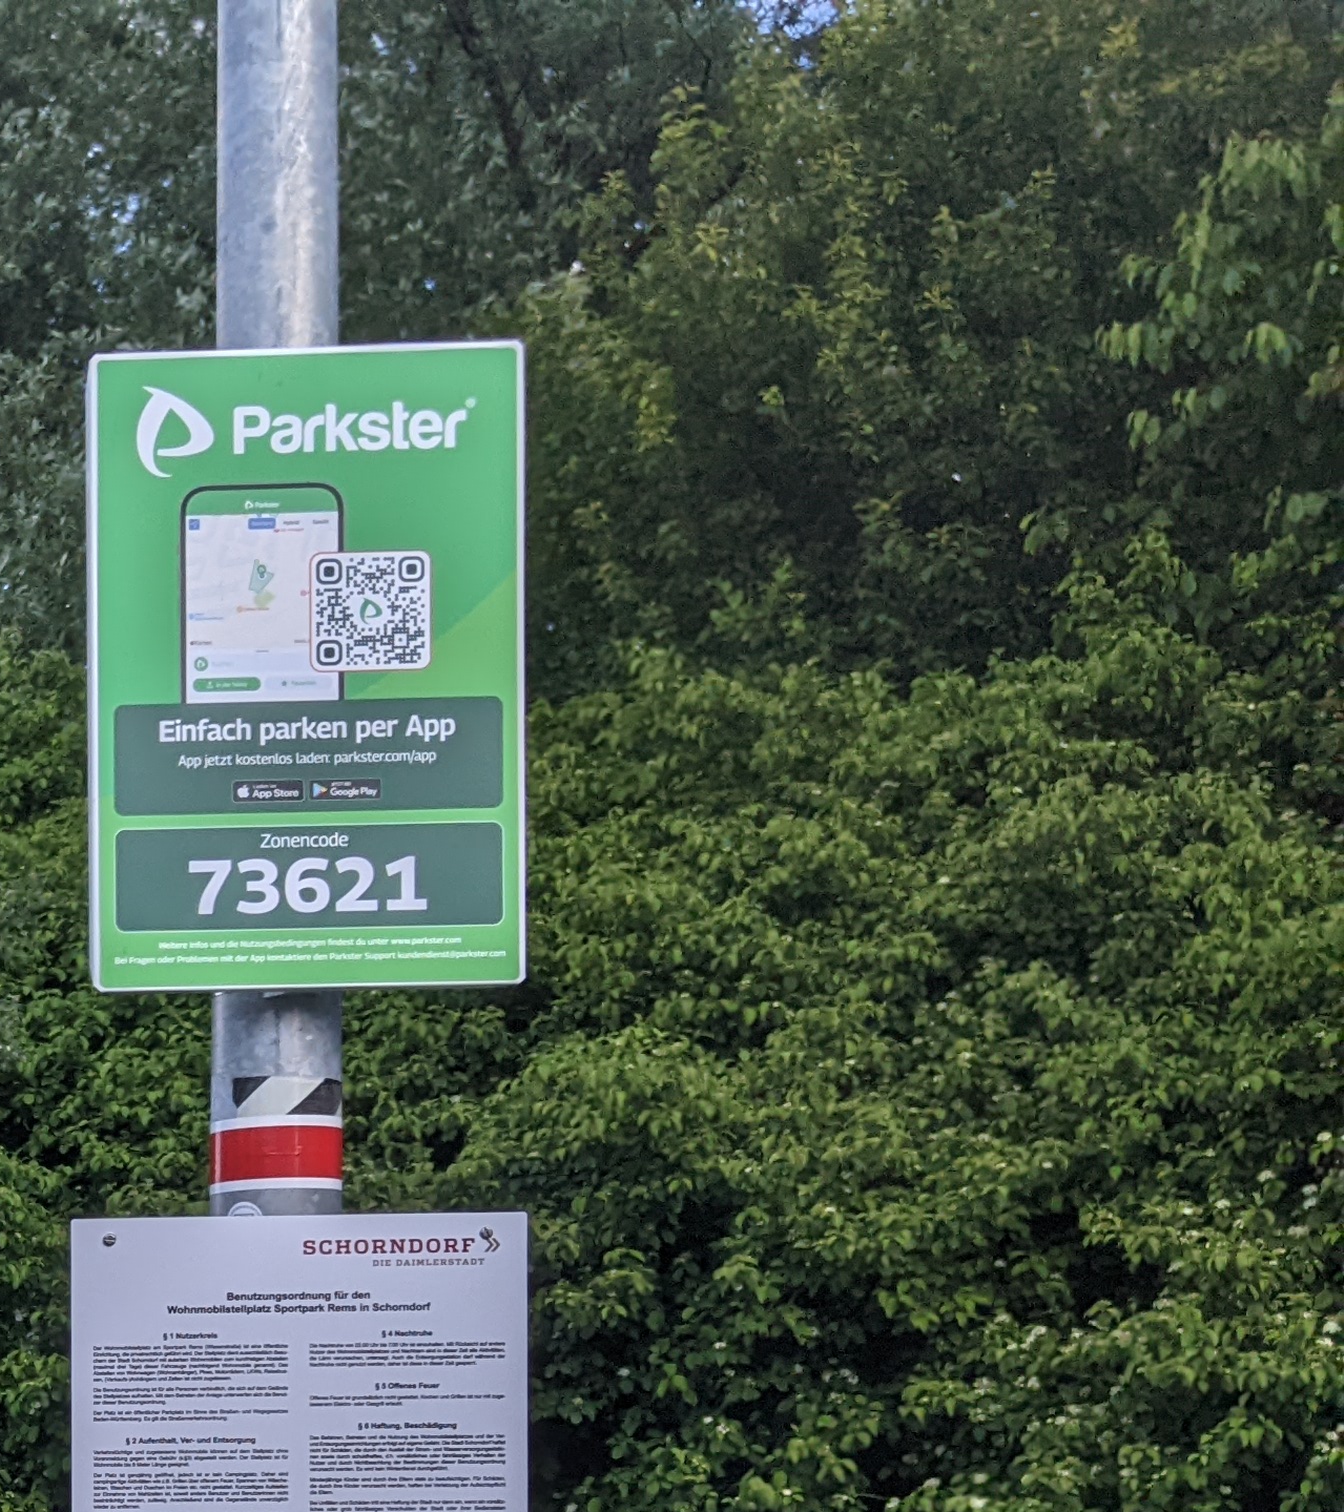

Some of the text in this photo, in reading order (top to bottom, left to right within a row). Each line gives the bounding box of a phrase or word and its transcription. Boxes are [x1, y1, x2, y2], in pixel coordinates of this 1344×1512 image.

[233, 401, 466, 455] Parkster
[159, 715, 456, 745] Einfach parken per App
[178, 750, 436, 768] App jetzt kostenlos laden: parkster.com/app
[252, 787, 299, 799] App Store
[330, 786, 377, 798] Google Play
[260, 832, 349, 848] Zonencode
[188, 856, 428, 915] 73621
[303, 1237, 476, 1255] SCHORNDORF
[372, 1258, 486, 1267] DIE DAIMLERSTADT
[226, 1291, 371, 1302] Benutzungsordnung für den
[167, 1302, 431, 1315] Wohnmobilstellplatz Sportpark Rems in Schorndorf
